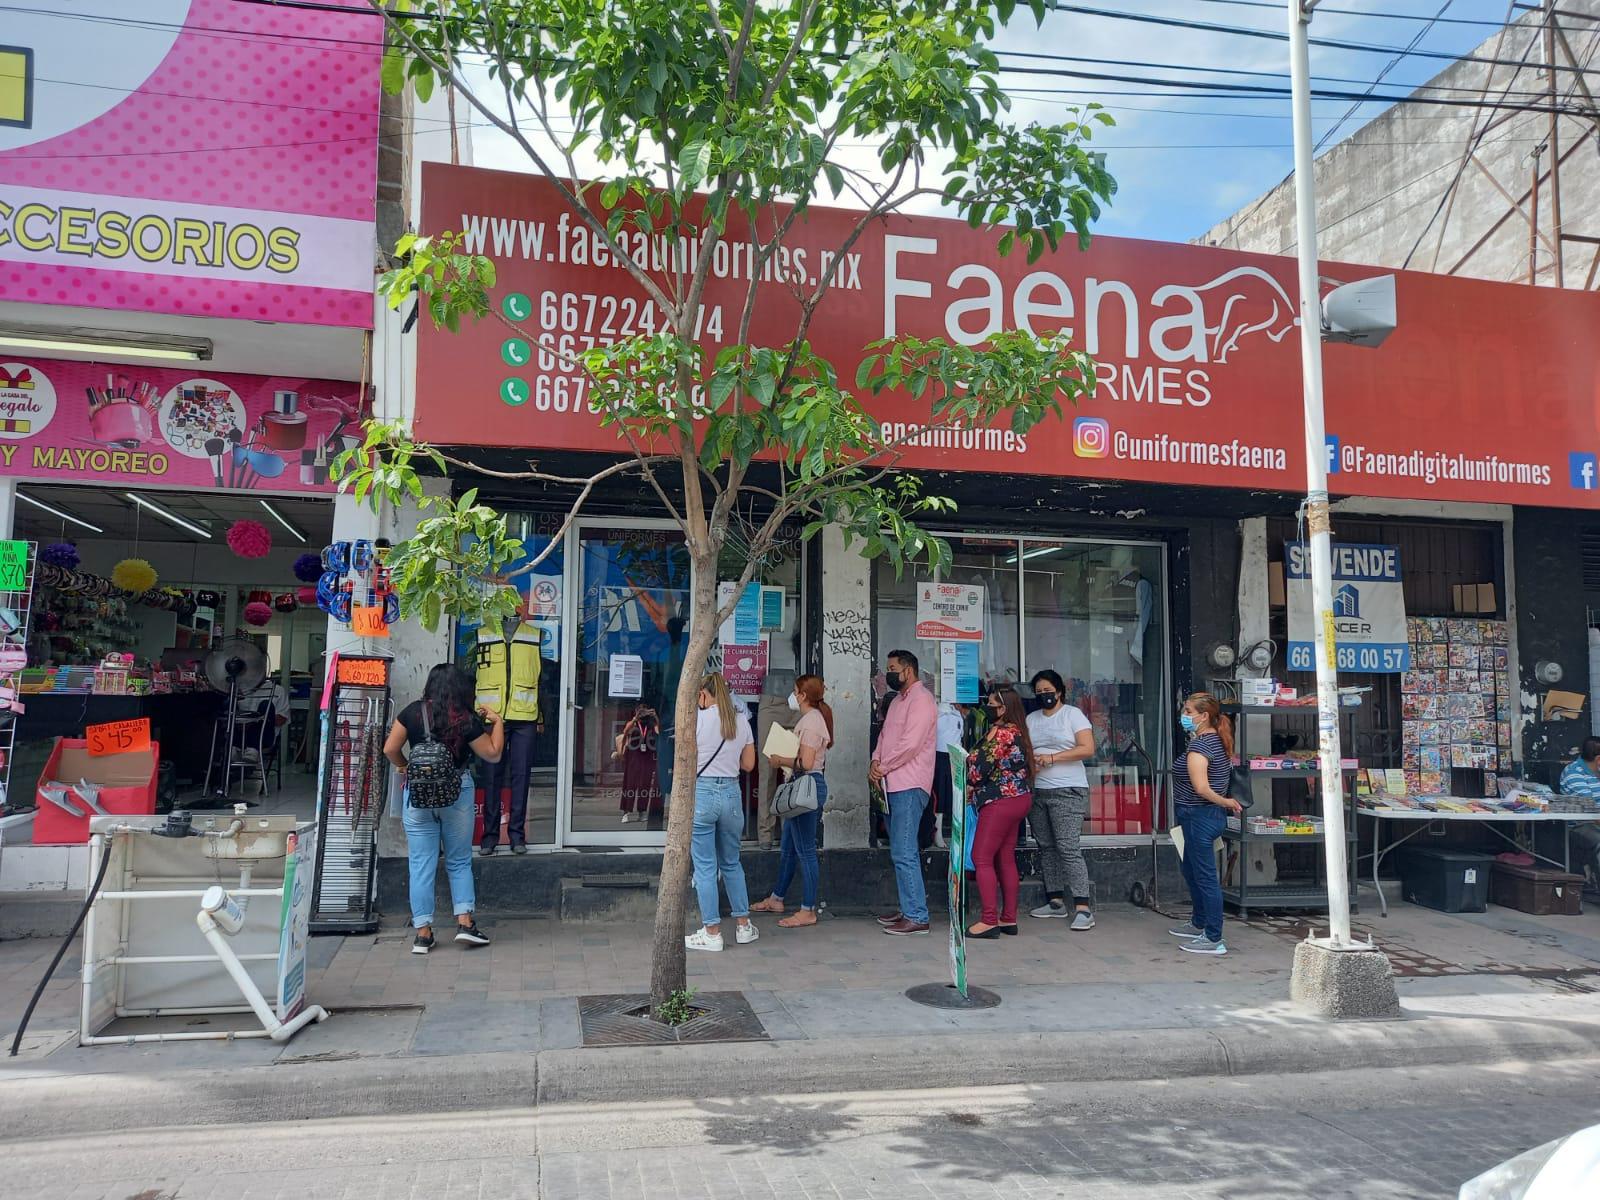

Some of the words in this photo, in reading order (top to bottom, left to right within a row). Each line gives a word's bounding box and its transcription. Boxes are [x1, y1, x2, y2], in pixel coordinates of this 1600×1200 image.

[0, 200, 300, 273] CESORIOS
[884, 235, 1209, 363] Faena
[32, 447, 169, 475] MAYOREO
[1114, 430, 1286, 471] @uniformesfaena
[1342, 445, 1551, 486] @Faenadigitaluniformes
[1, 563, 25, 587] $70
[1360, 649, 1378, 669] 00
[1383, 649, 1404, 669] 57
